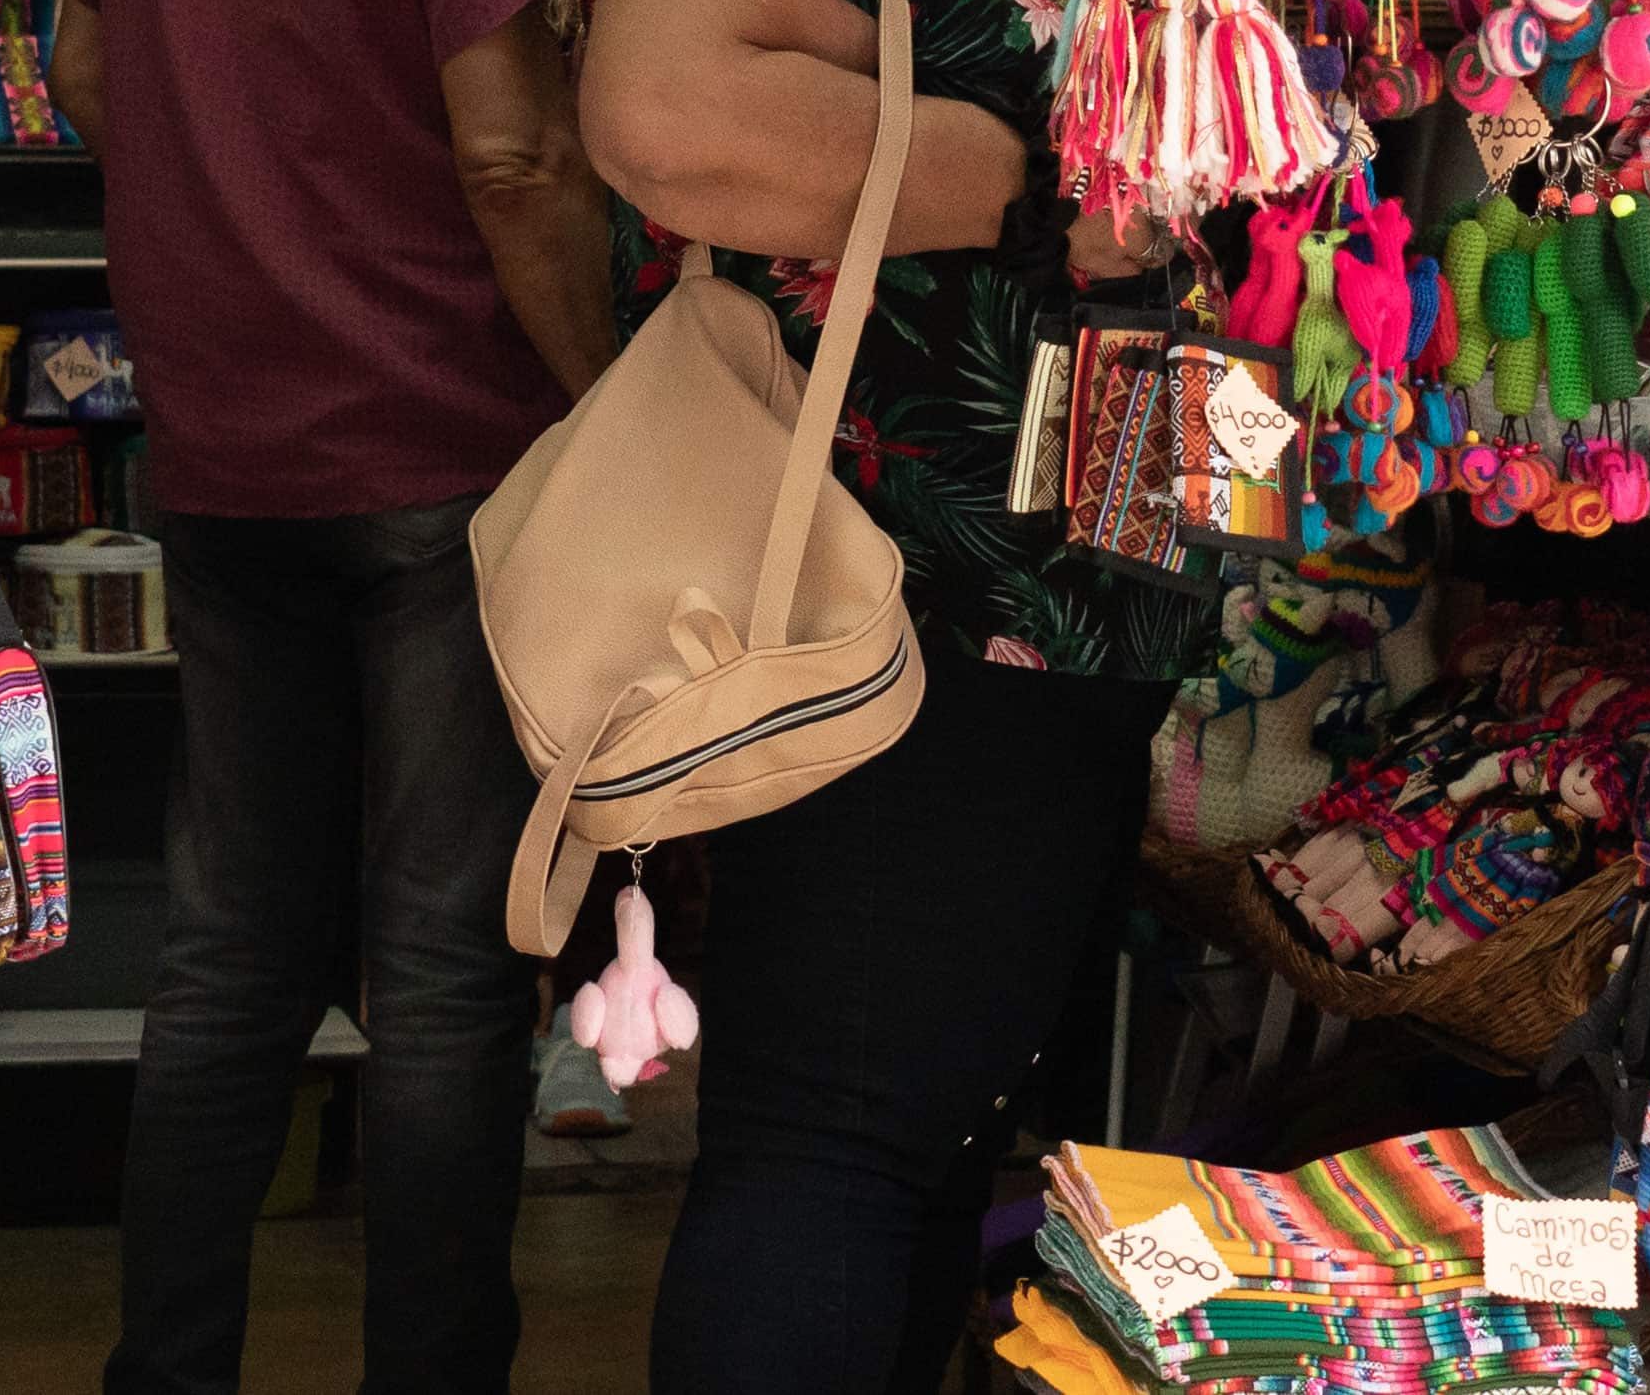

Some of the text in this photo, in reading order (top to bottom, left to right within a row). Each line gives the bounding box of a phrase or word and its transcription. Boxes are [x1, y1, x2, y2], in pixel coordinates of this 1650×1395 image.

[1209, 401, 1287, 431] $4000
[1495, 1202, 1631, 1251] Caminos
[1109, 1231, 1220, 1282] $2000
